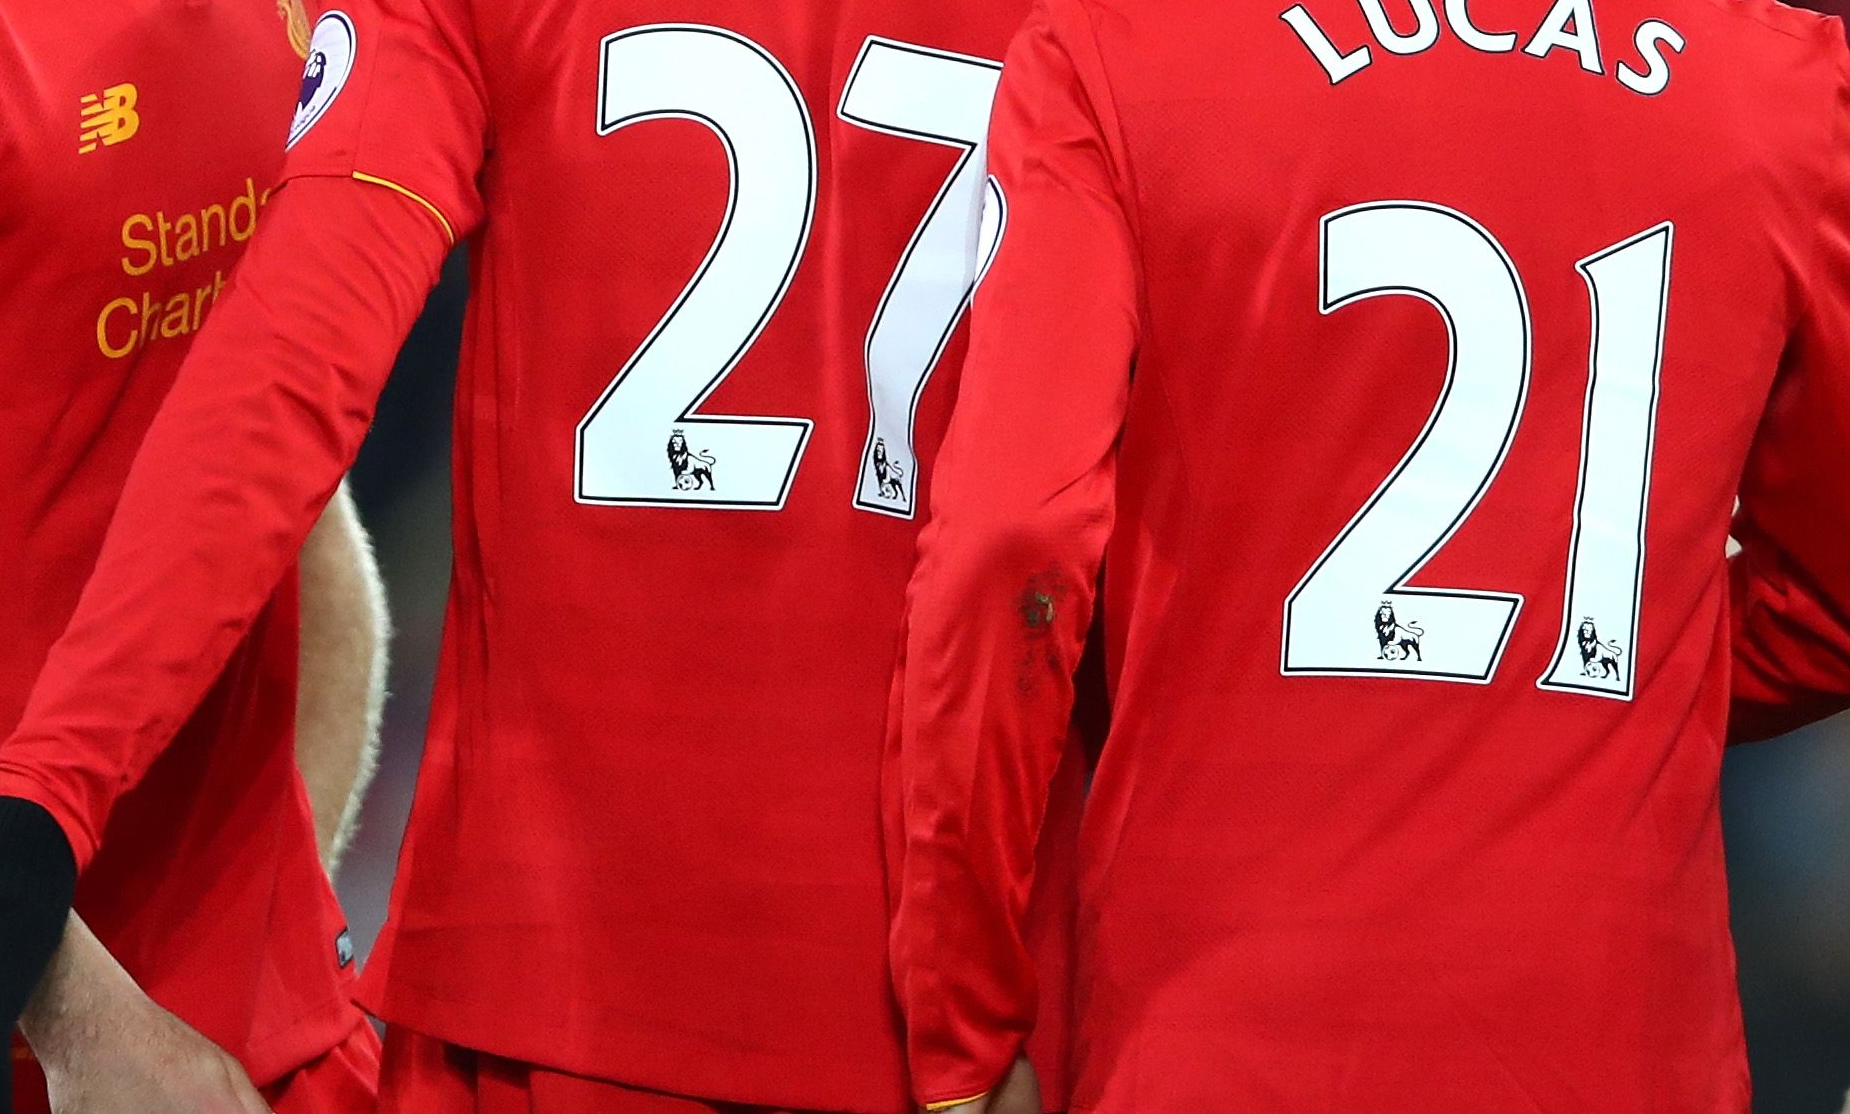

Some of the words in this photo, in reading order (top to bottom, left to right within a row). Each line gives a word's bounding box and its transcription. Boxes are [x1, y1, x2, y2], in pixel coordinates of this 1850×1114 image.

[121, 177, 271, 276] Stand
[573, 22, 1006, 520] 27
[1280, 199, 1674, 702] 21
